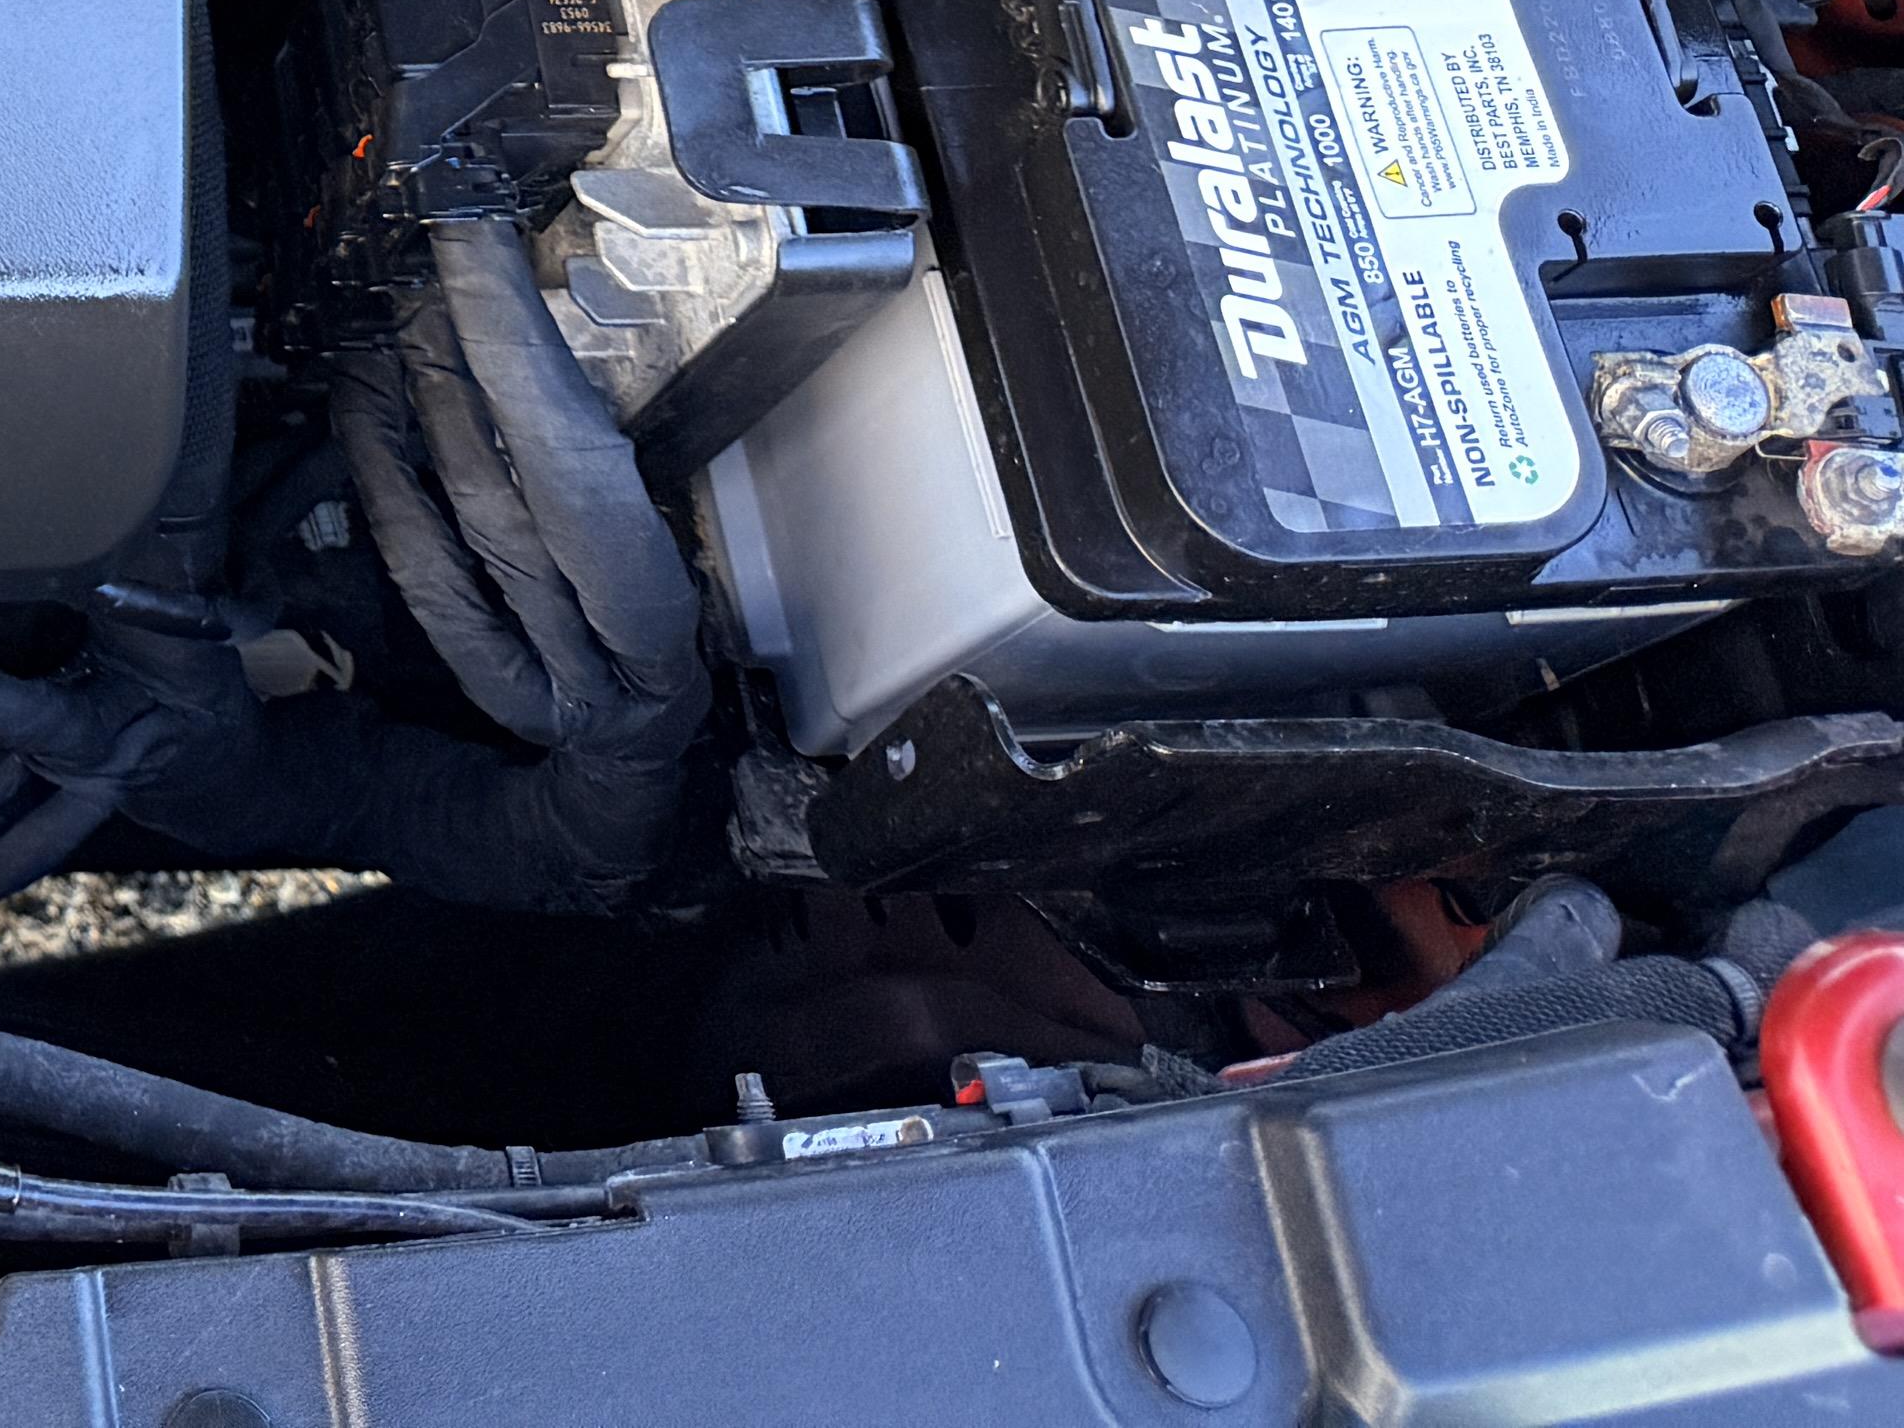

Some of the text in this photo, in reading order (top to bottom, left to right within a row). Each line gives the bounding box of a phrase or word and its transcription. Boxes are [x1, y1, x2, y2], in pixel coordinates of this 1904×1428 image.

[1271, 2, 1301, 40] 140
[1309, 113, 1342, 166] 1000
[1346, 57, 1388, 154] WARNING:
[1379, 71, 1408, 142] Reproductive
[1403, 99, 1418, 123] after
[1413, 125, 1430, 159] hands
[1440, 52, 1496, 170] DISTRIBUTED BY
[1462, 45, 1518, 169] BEST PARTS, INC.
[1477, 33, 1539, 167] MEMPHIS, TN 38103
[1525, 88, 1560, 167] Made in India
[1133, 21, 1303, 375] Duralast
[1245, 26, 1375, 364] AGM TECHNOLOGY
[1401, 144, 1418, 165] and
[1411, 168, 1432, 207] Cancer
[1424, 161, 1442, 192] Wash
[1353, 241, 1384, 284] 850
[1403, 271, 1494, 486] NON-SPILLABLE
[1445, 279, 1512, 448] Return used batteries to
[1447, 240, 1528, 447] AutoZone for proper recycling
[1388, 347, 1440, 446] H7-AGM
